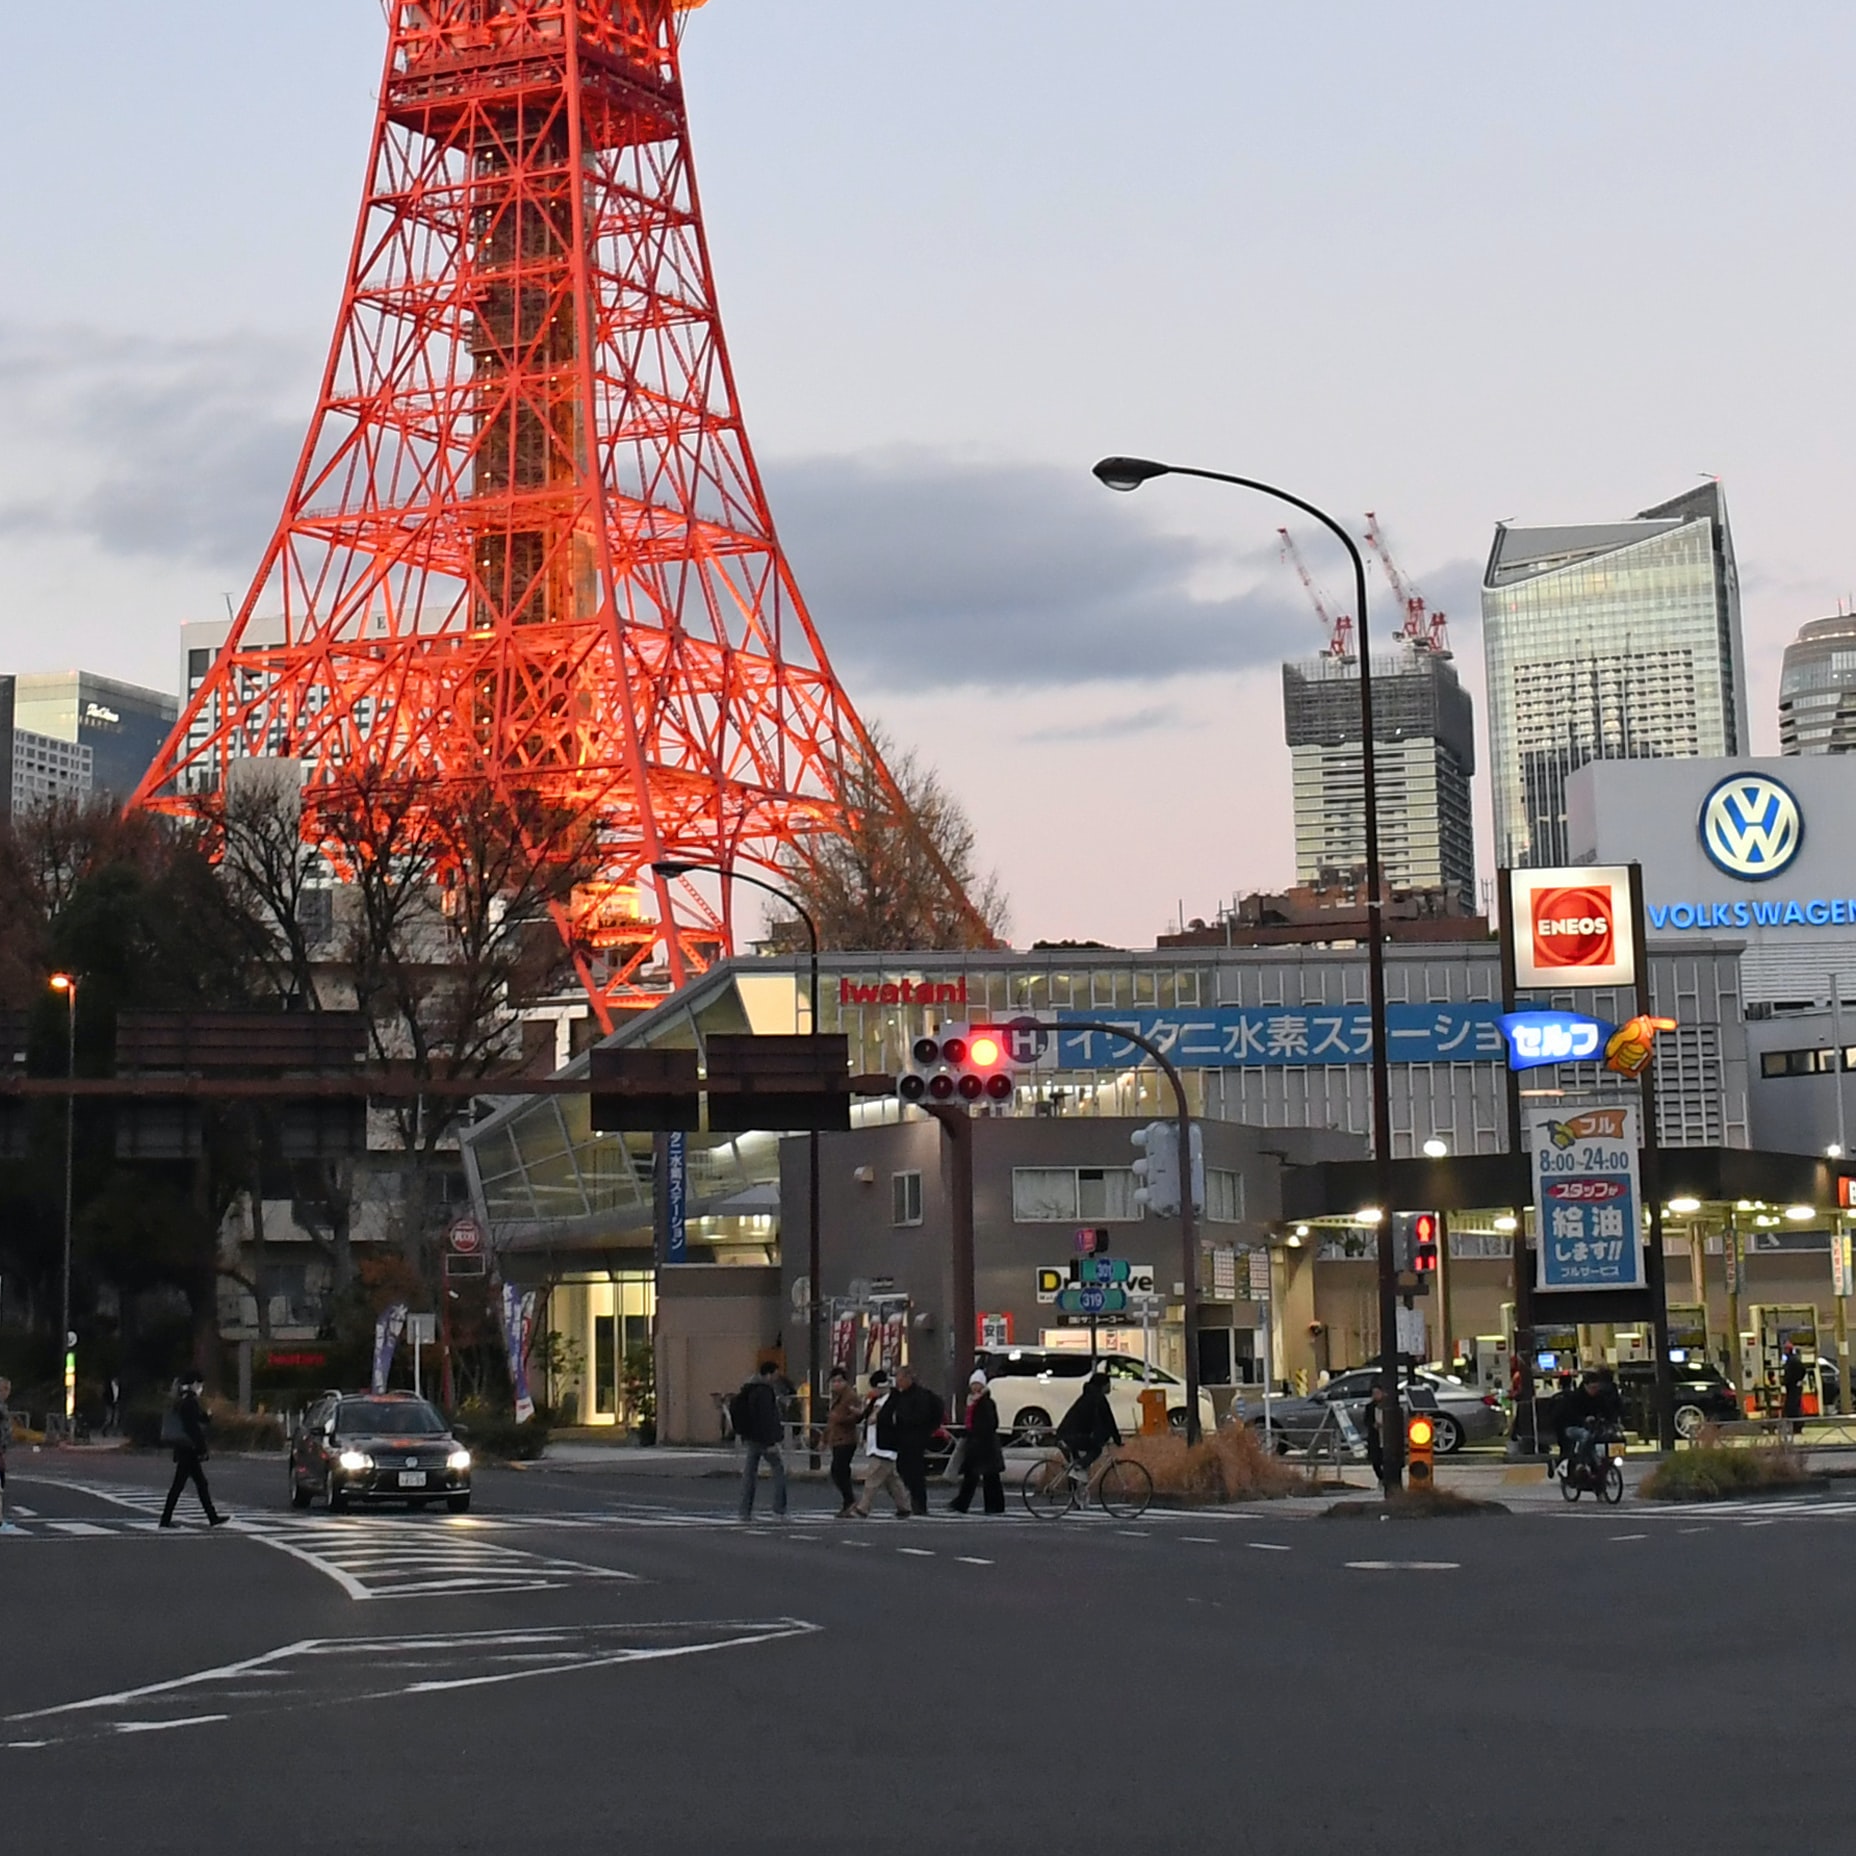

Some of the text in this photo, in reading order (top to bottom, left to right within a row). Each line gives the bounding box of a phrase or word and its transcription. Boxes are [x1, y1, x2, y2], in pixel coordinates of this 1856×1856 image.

[1537, 916, 1609, 937] ENEOS
[839, 975, 967, 1005] Iwatani
[1512, 1022, 1599, 1057] セルフ
[1578, 1116, 1616, 1135] フル
[1556, 1182, 1618, 1199] スタッフが
[1552, 1205, 1624, 1239] 給油
[1082, 1292, 1103, 1307] 319
